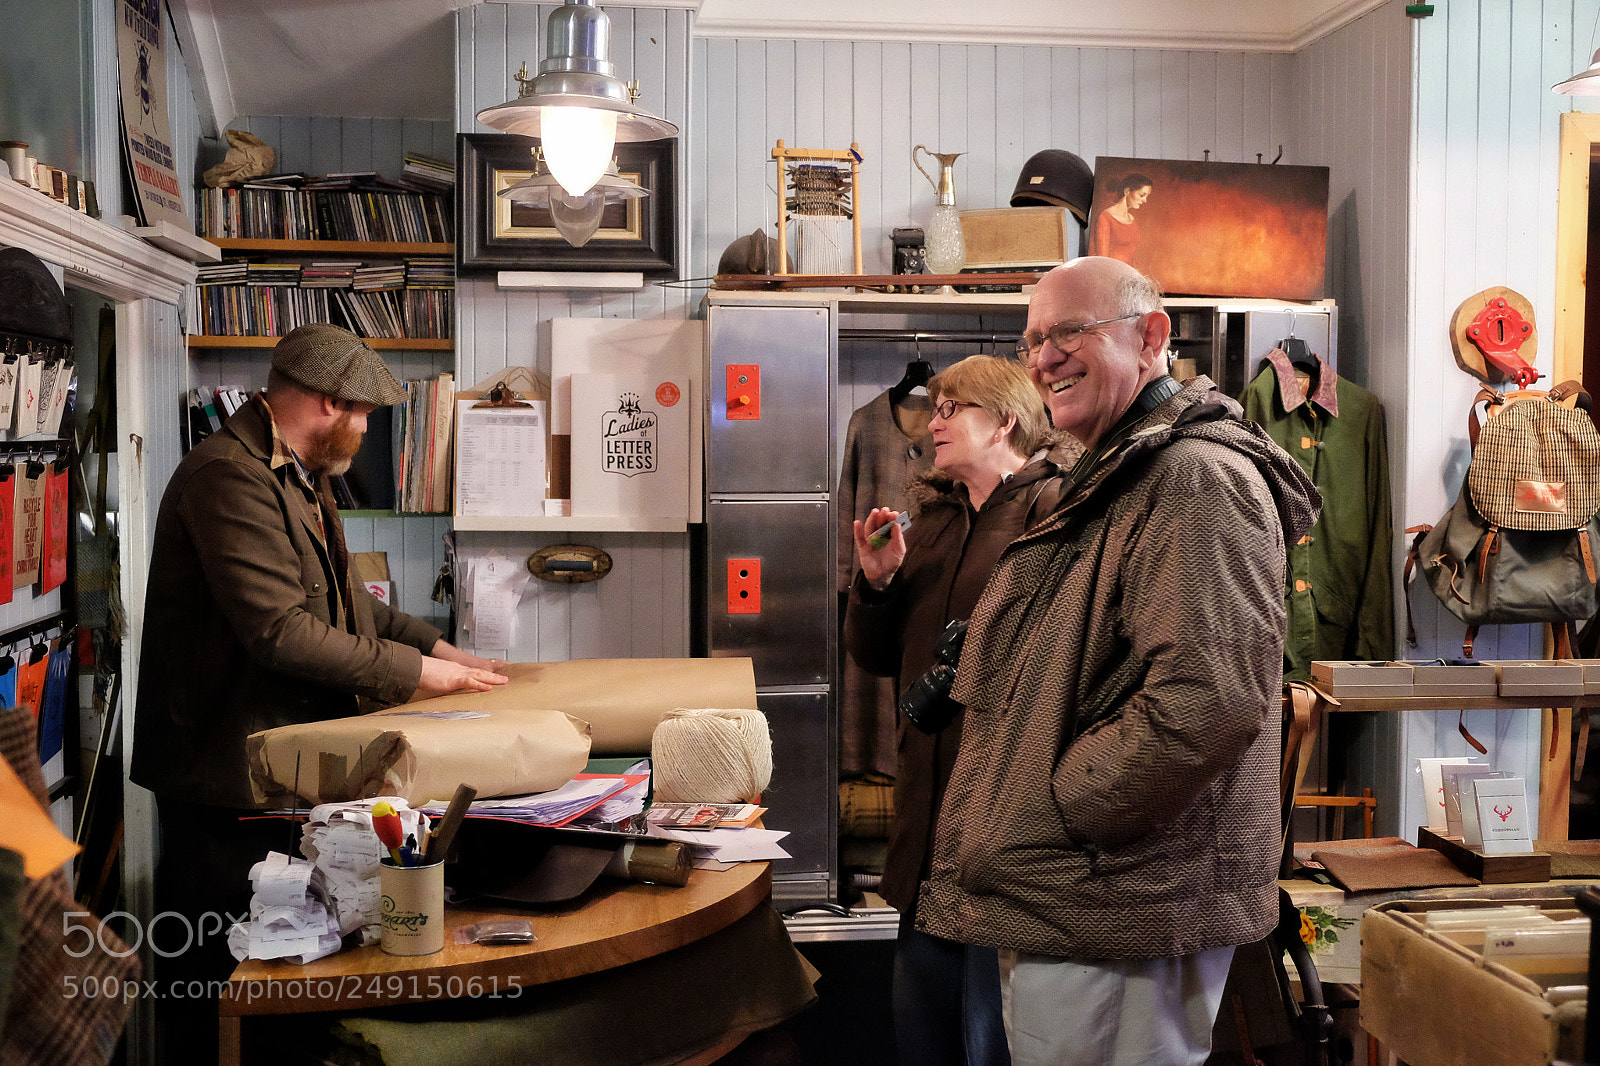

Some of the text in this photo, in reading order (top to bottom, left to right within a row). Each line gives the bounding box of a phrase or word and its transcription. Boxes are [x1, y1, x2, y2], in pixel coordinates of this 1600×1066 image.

[604, 415, 655, 438] Ladies
[640, 430, 647, 438] of
[607, 440, 653, 455] LETTER
[607, 455, 653, 470] PRESS
